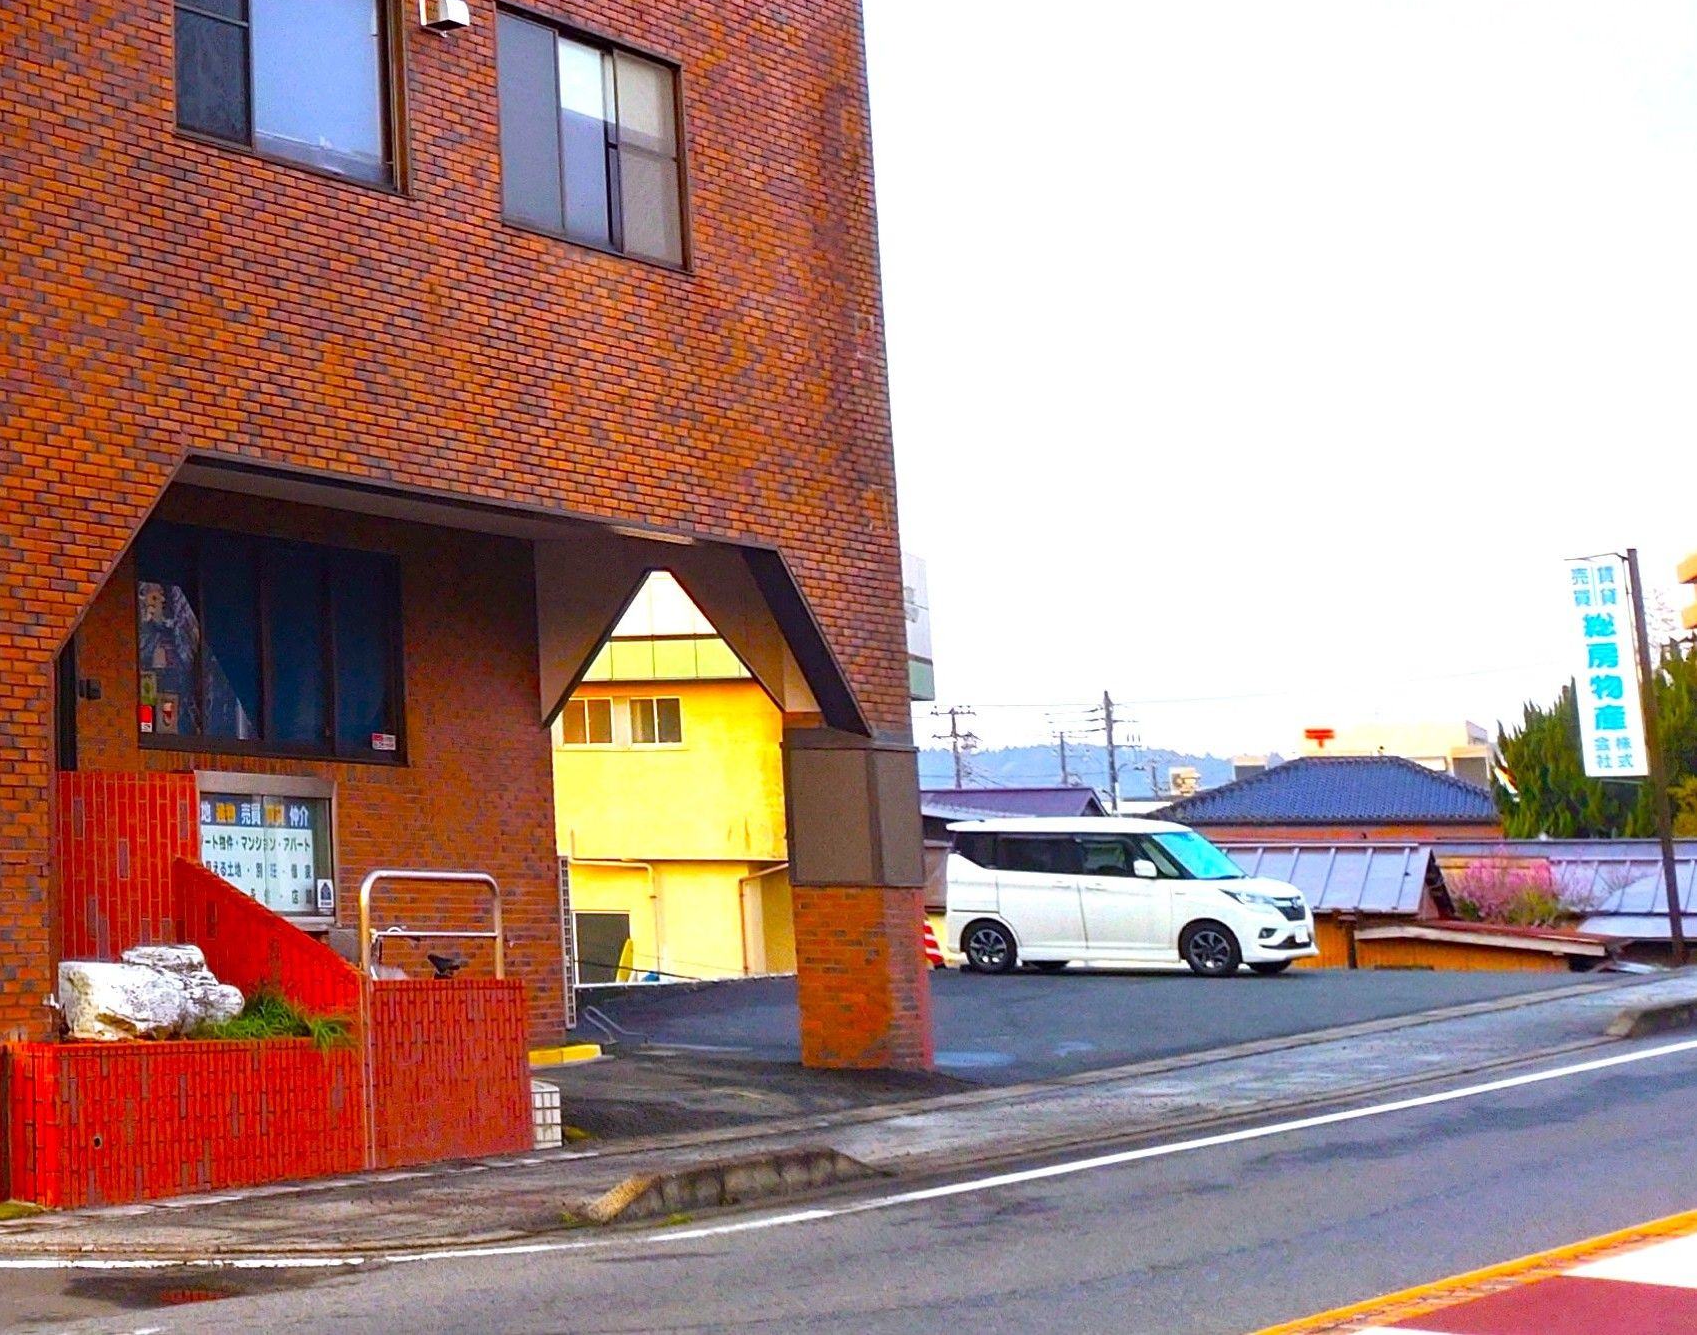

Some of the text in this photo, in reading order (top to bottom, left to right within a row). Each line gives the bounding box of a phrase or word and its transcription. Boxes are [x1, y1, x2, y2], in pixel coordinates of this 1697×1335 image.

[1571, 568, 1591, 606] 売買
[1583, 613, 1627, 730] 総房物産
